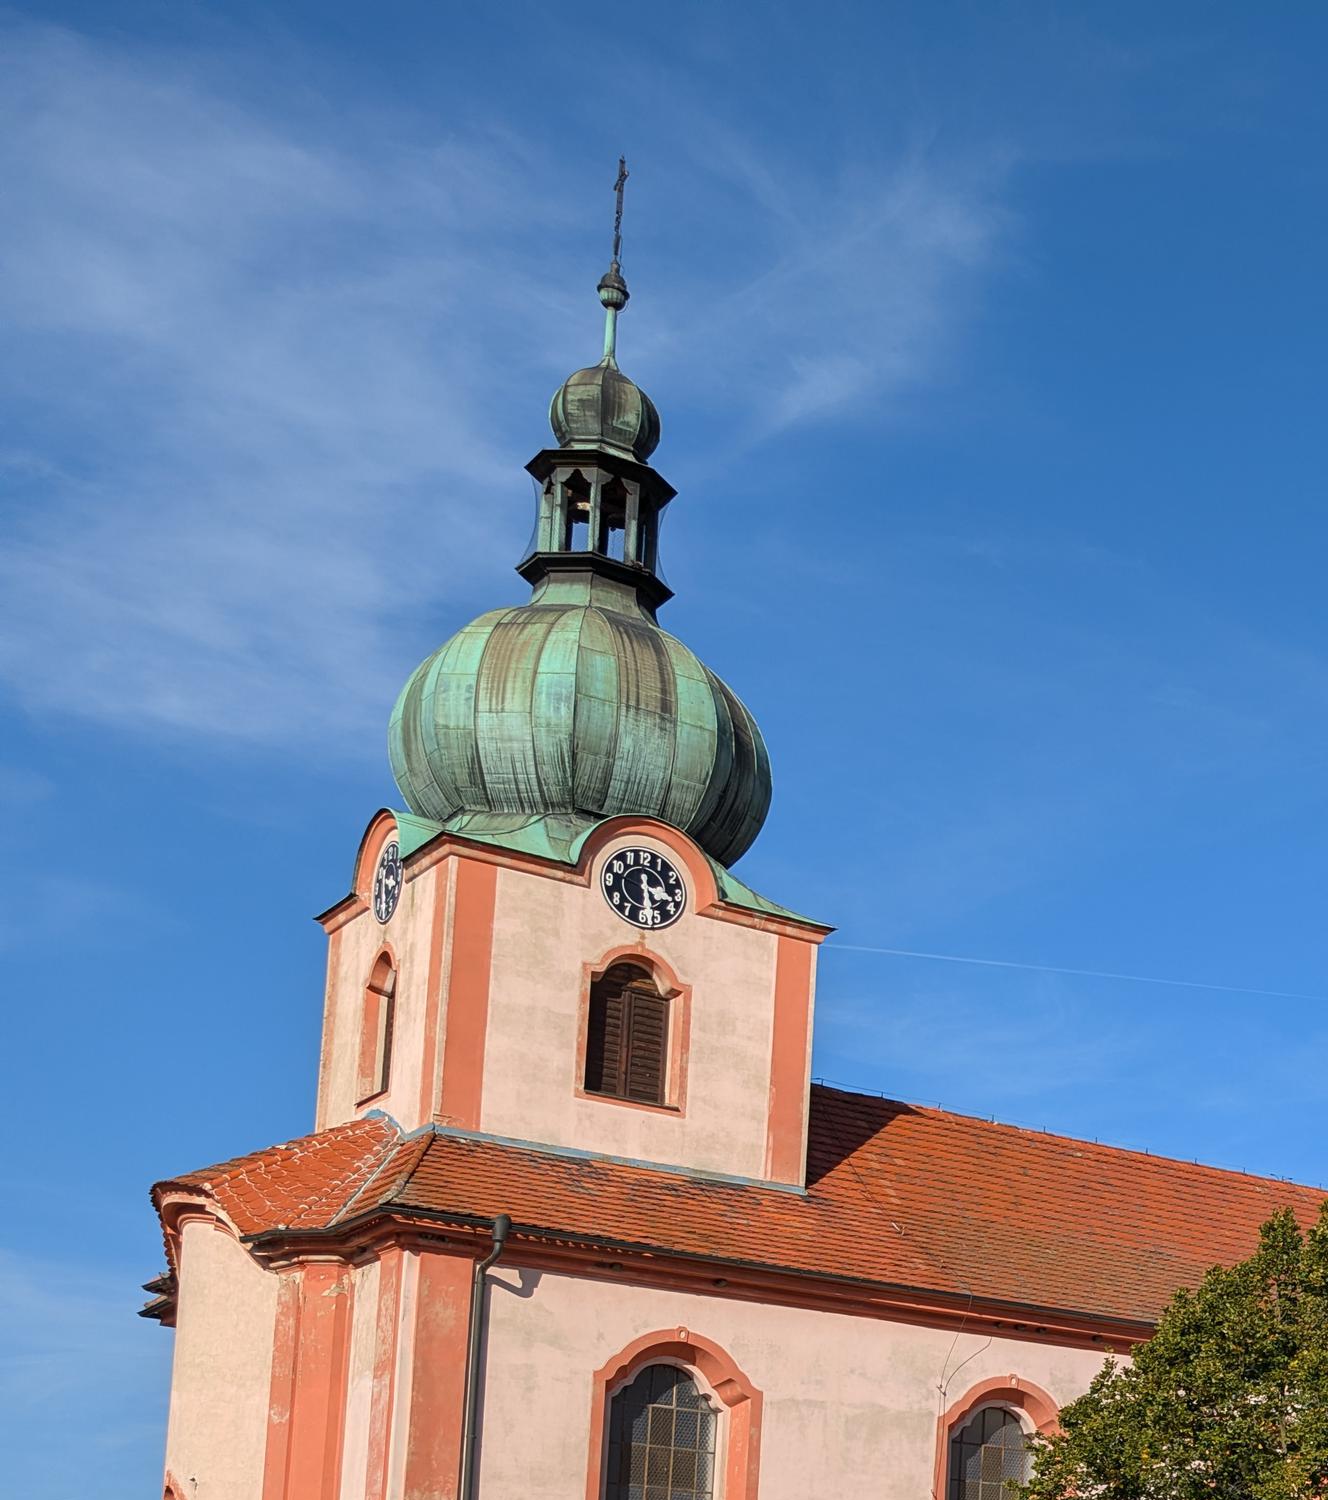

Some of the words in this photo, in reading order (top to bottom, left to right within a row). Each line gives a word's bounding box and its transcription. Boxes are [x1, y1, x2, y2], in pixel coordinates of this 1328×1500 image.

[626, 851, 635, 866] 11
[639, 851, 652, 866] 12
[656, 858, 662, 871] 1
[613, 860, 624, 874] 10
[605, 873, 614, 886] 9
[669, 871, 677, 884] 2
[613, 892, 620, 905] 8
[674, 889, 682, 902] 3
[623, 902, 632, 916] 7
[666, 902, 676, 915] 4
[639, 910, 647, 923] 6
[653, 910, 661, 924] 5
